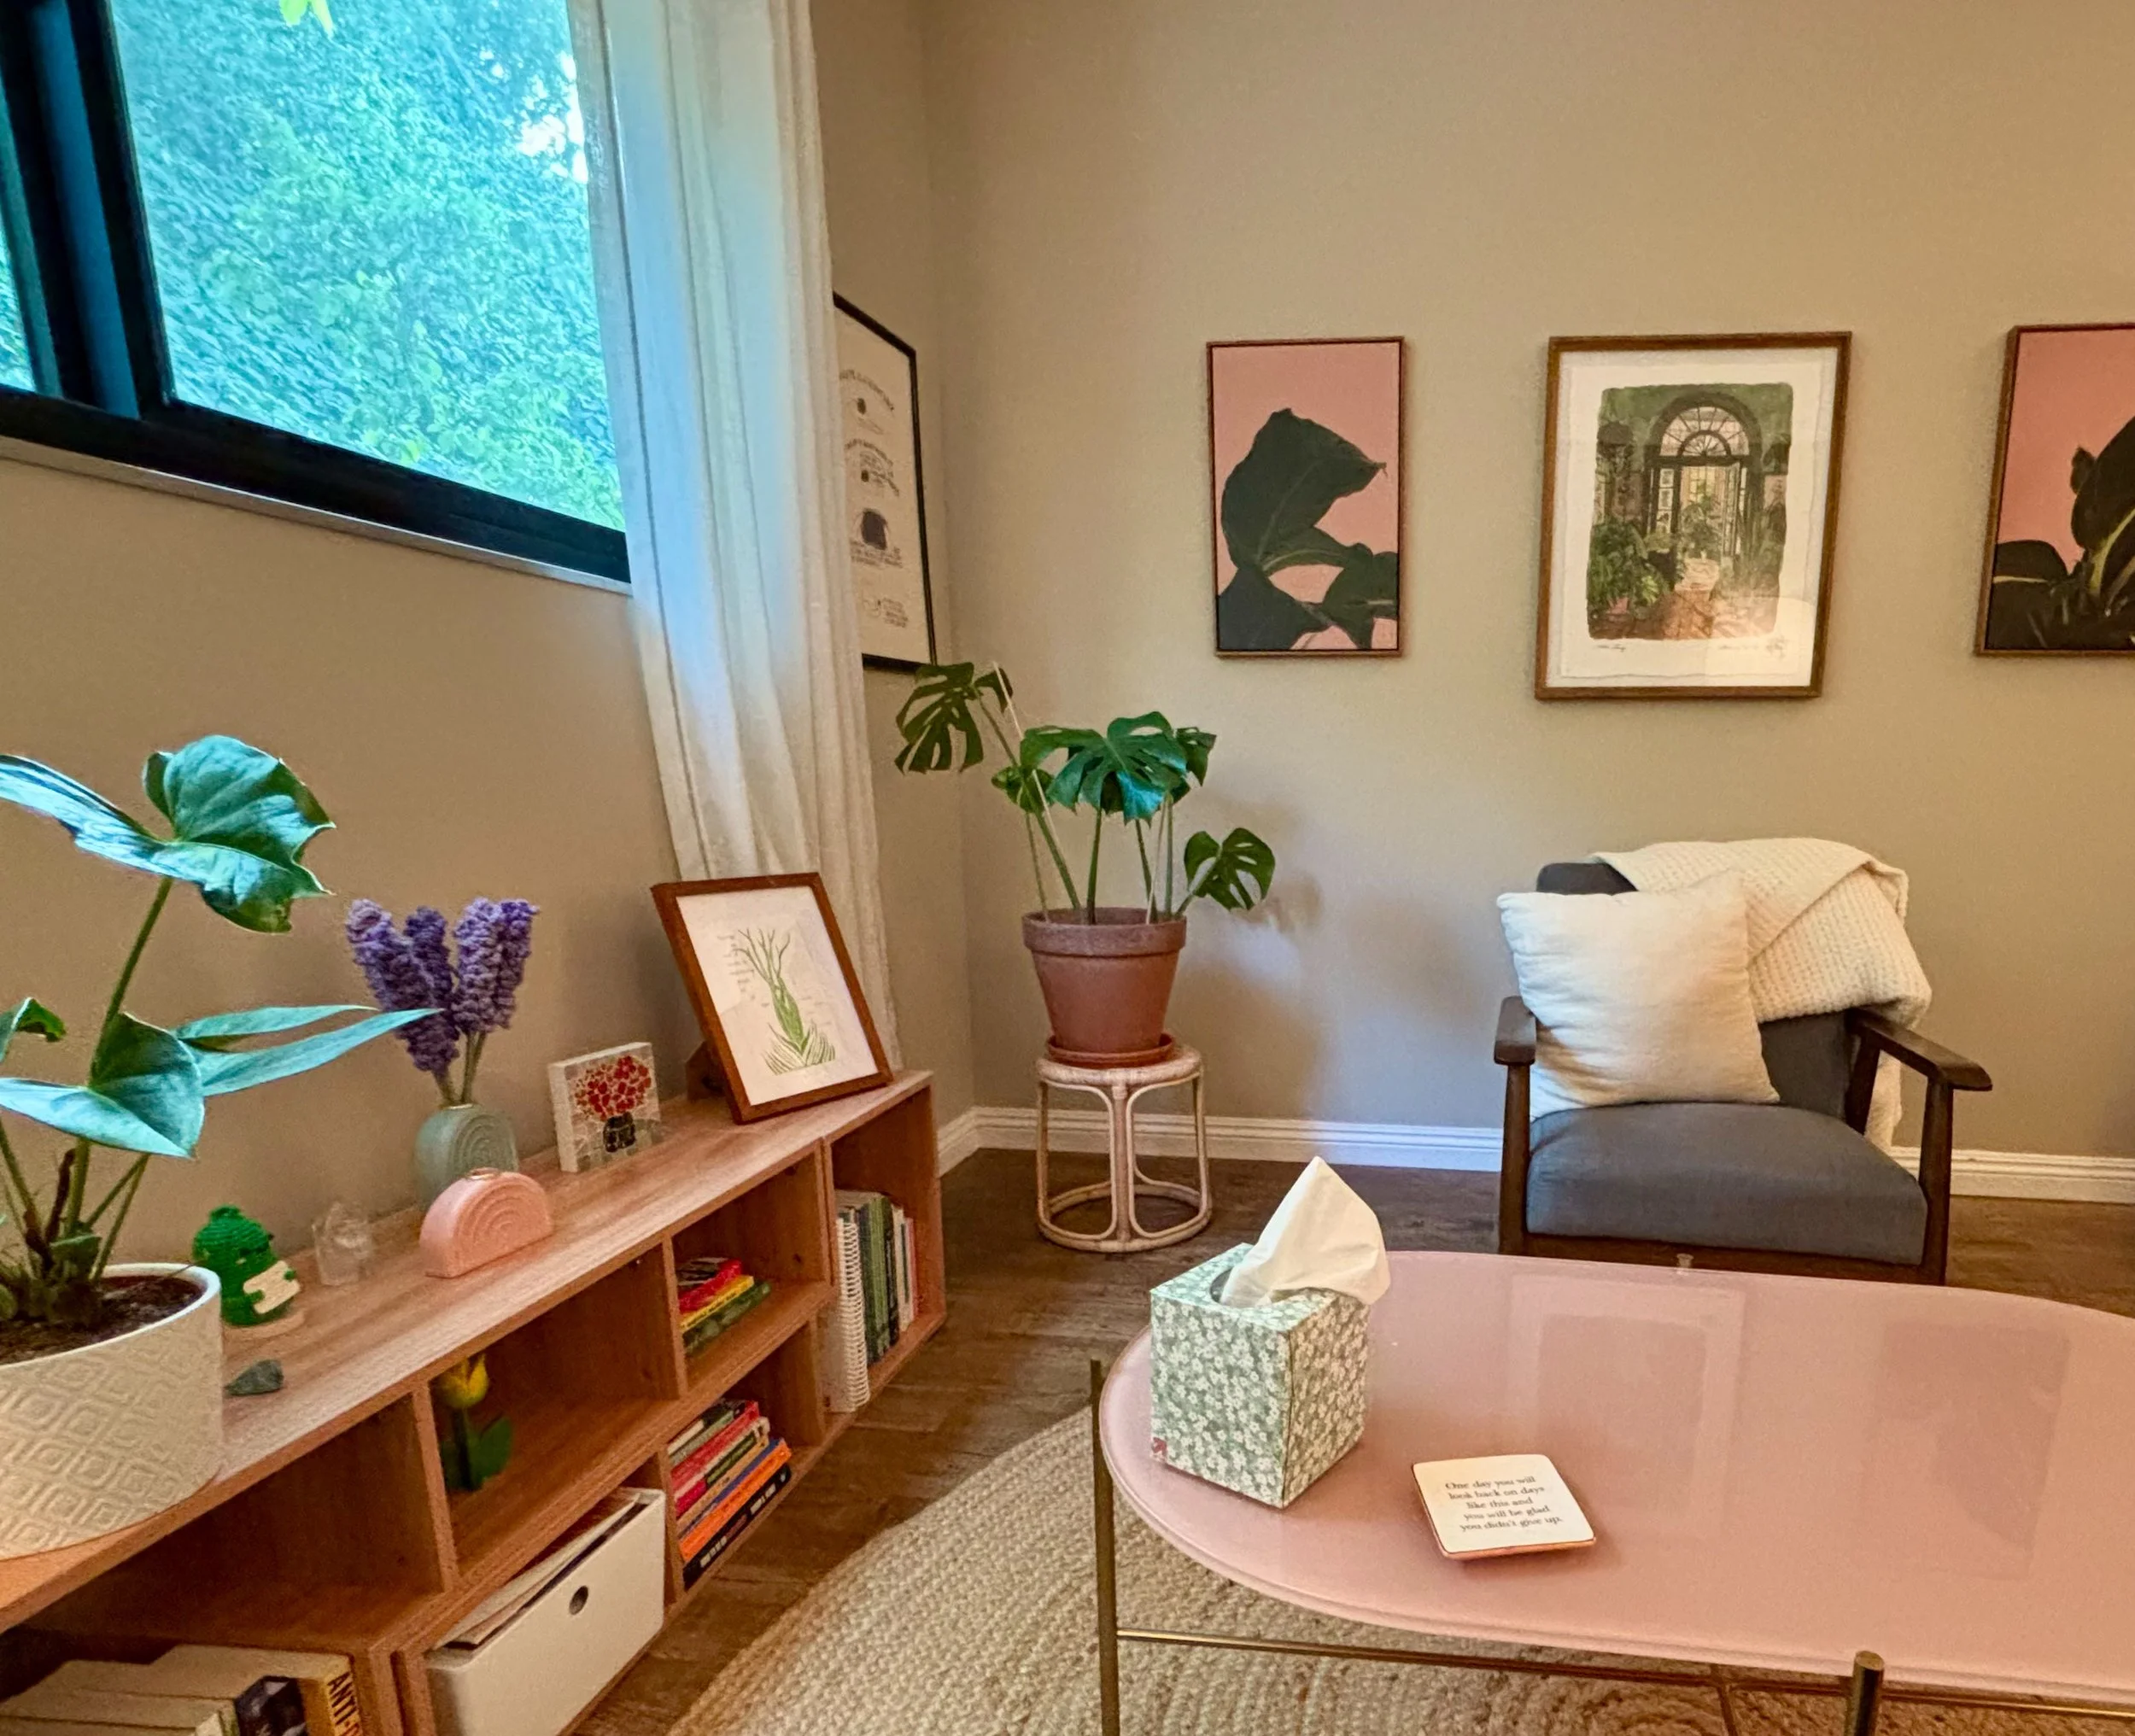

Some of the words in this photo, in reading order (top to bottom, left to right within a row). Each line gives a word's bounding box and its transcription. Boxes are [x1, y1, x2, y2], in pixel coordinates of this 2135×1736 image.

[1472, 1480, 1491, 1488] day
[1494, 1480, 1515, 1489] you
[1516, 1476, 1536, 1484] will
[1474, 1488, 1501, 1498] back
[1520, 1486, 1545, 1494] days
[1466, 1501, 1487, 1510] like
[1489, 1499, 1511, 1508] this
[1512, 1496, 1534, 1505] and
[1487, 1510, 1506, 1518] will
[1526, 1505, 1550, 1516] glad
[1483, 1519, 1518, 1529] didn't
[1519, 1518, 1543, 1528] give
